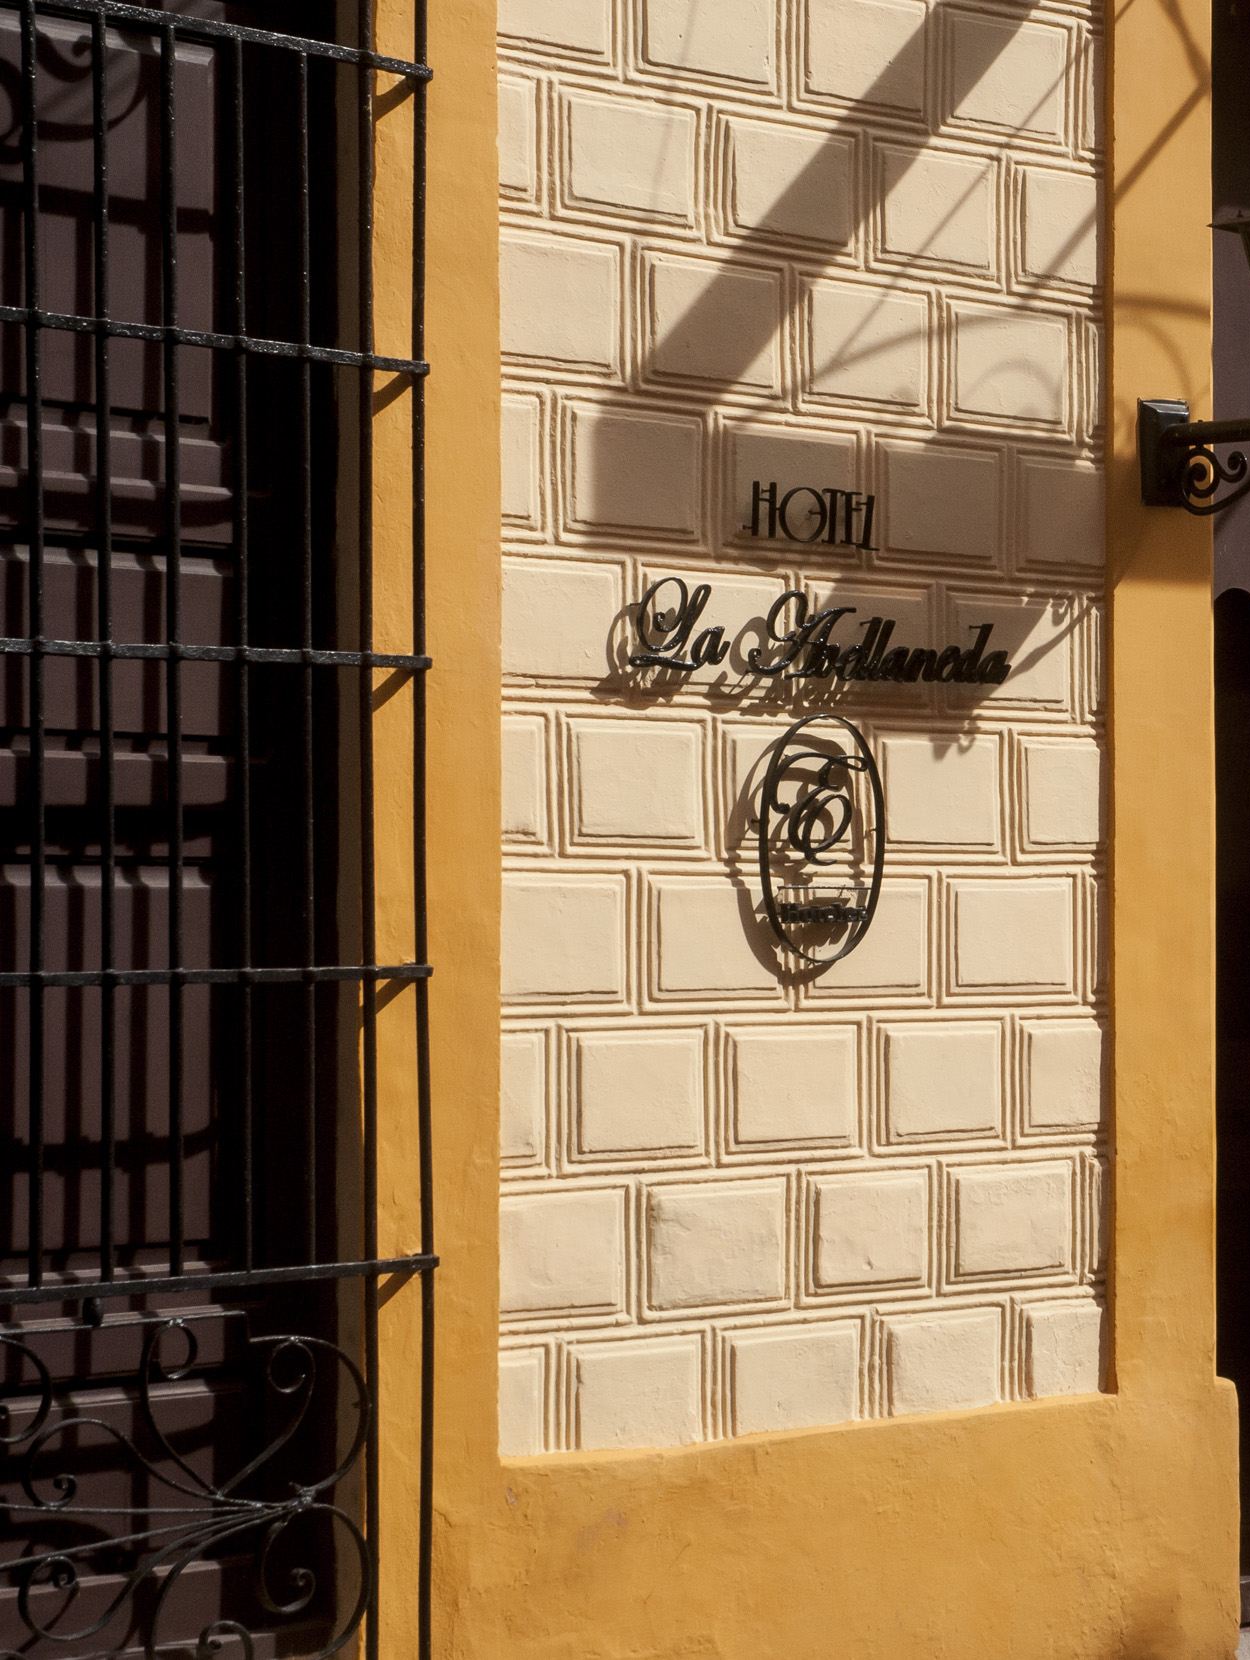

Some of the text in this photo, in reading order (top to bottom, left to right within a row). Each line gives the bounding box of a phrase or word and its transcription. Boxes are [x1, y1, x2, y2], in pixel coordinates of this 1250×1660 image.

[752, 481, 879, 551] HOTEL
[629, 577, 1012, 685] La Avellaneda
